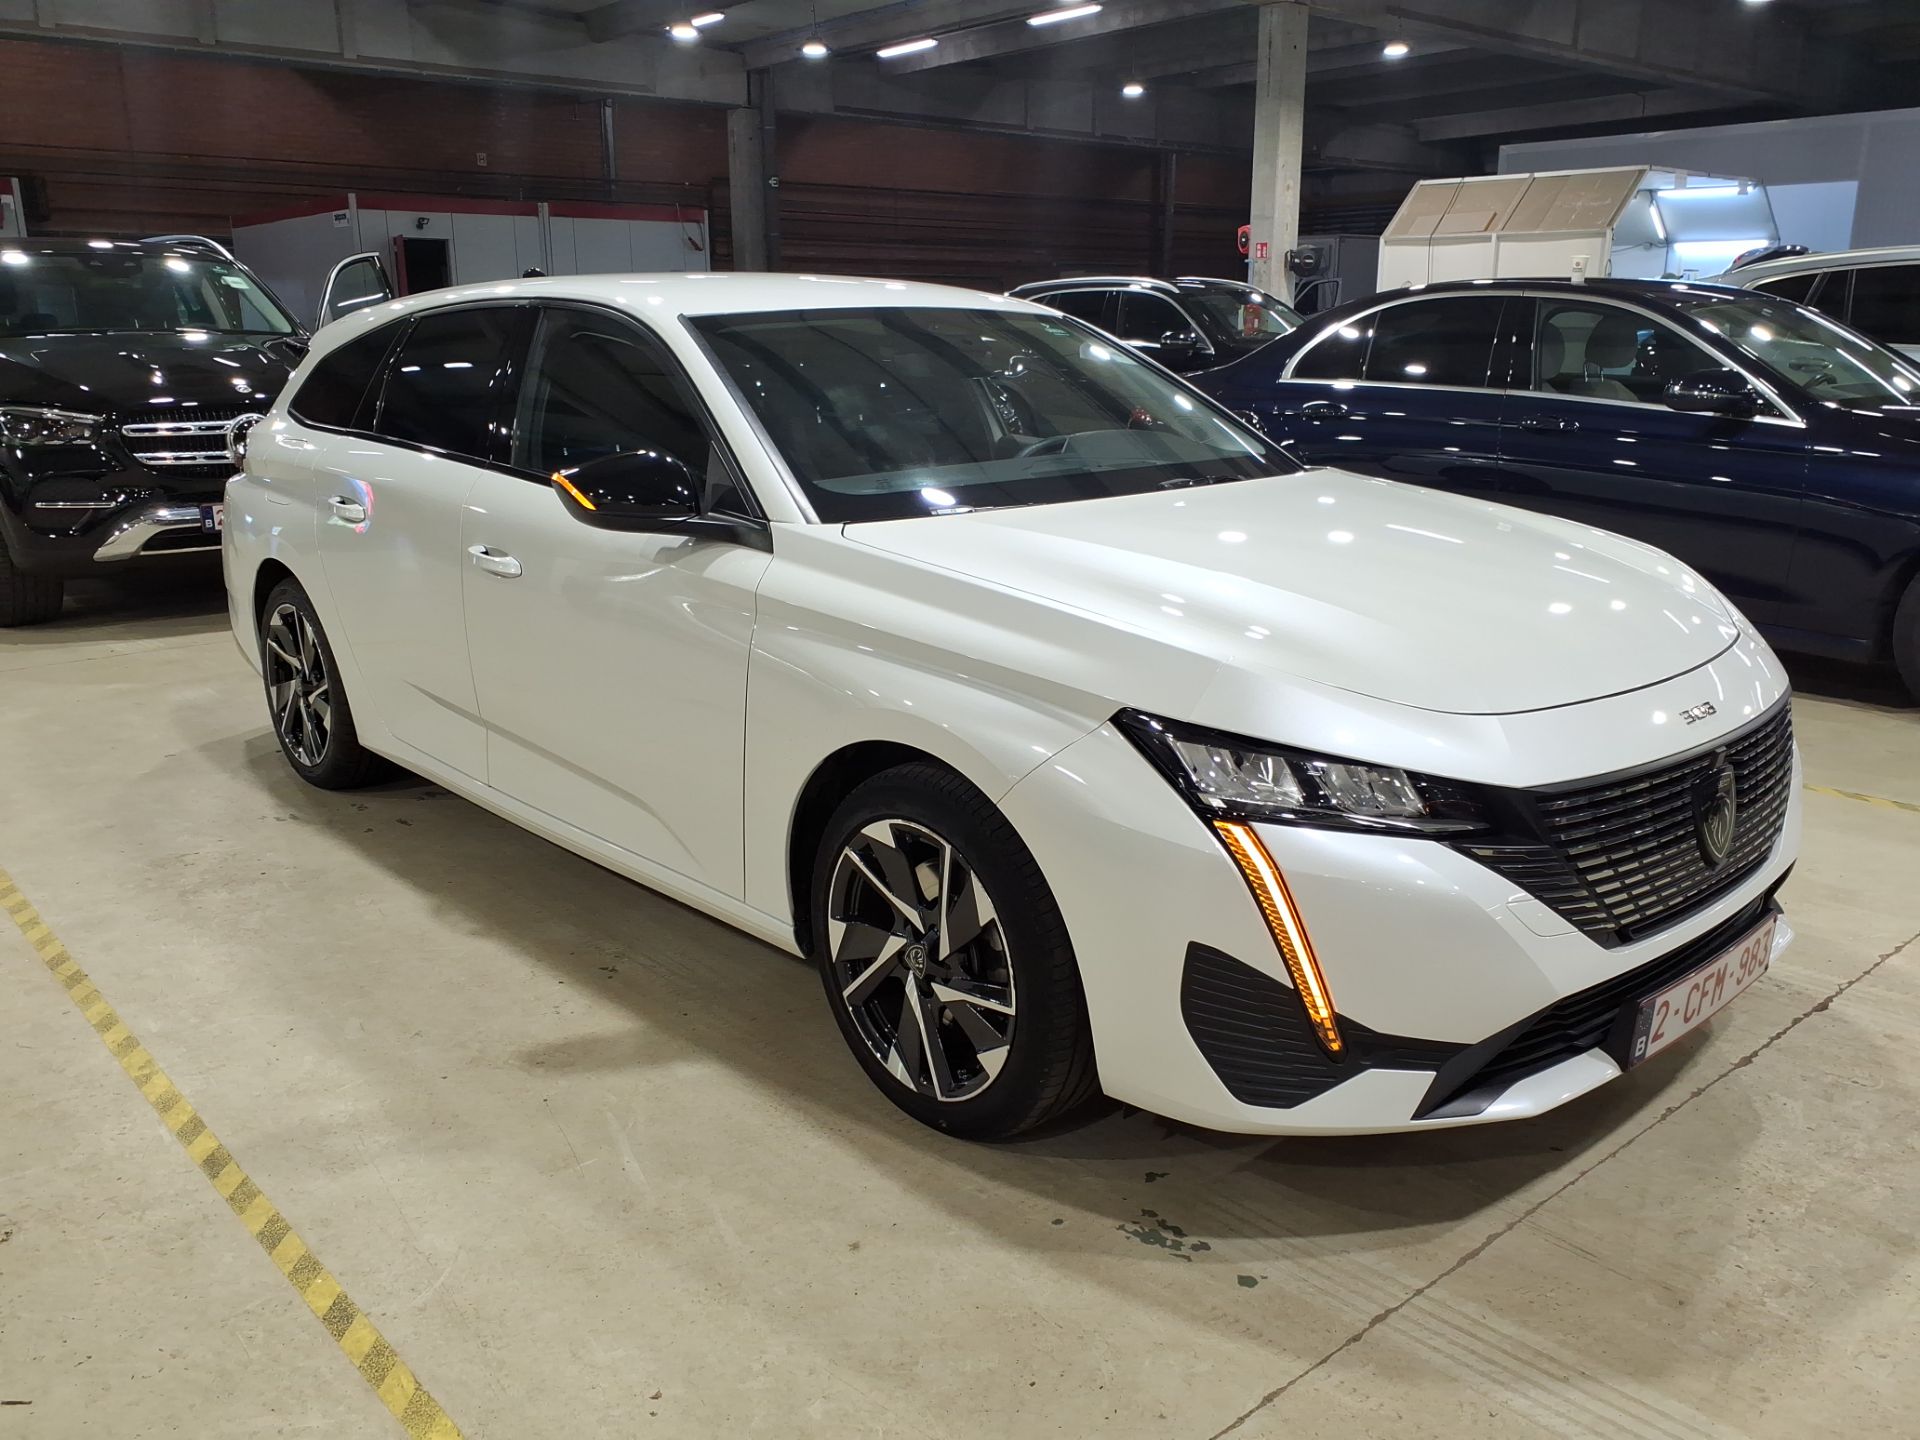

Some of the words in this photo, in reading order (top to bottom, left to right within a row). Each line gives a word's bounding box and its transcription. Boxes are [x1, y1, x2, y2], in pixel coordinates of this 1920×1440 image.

[205, 519, 213, 528] B
[1679, 701, 1717, 725] 308
[1651, 928, 1772, 1044] 2-CFM-983
[1635, 1035, 1647, 1057] B
